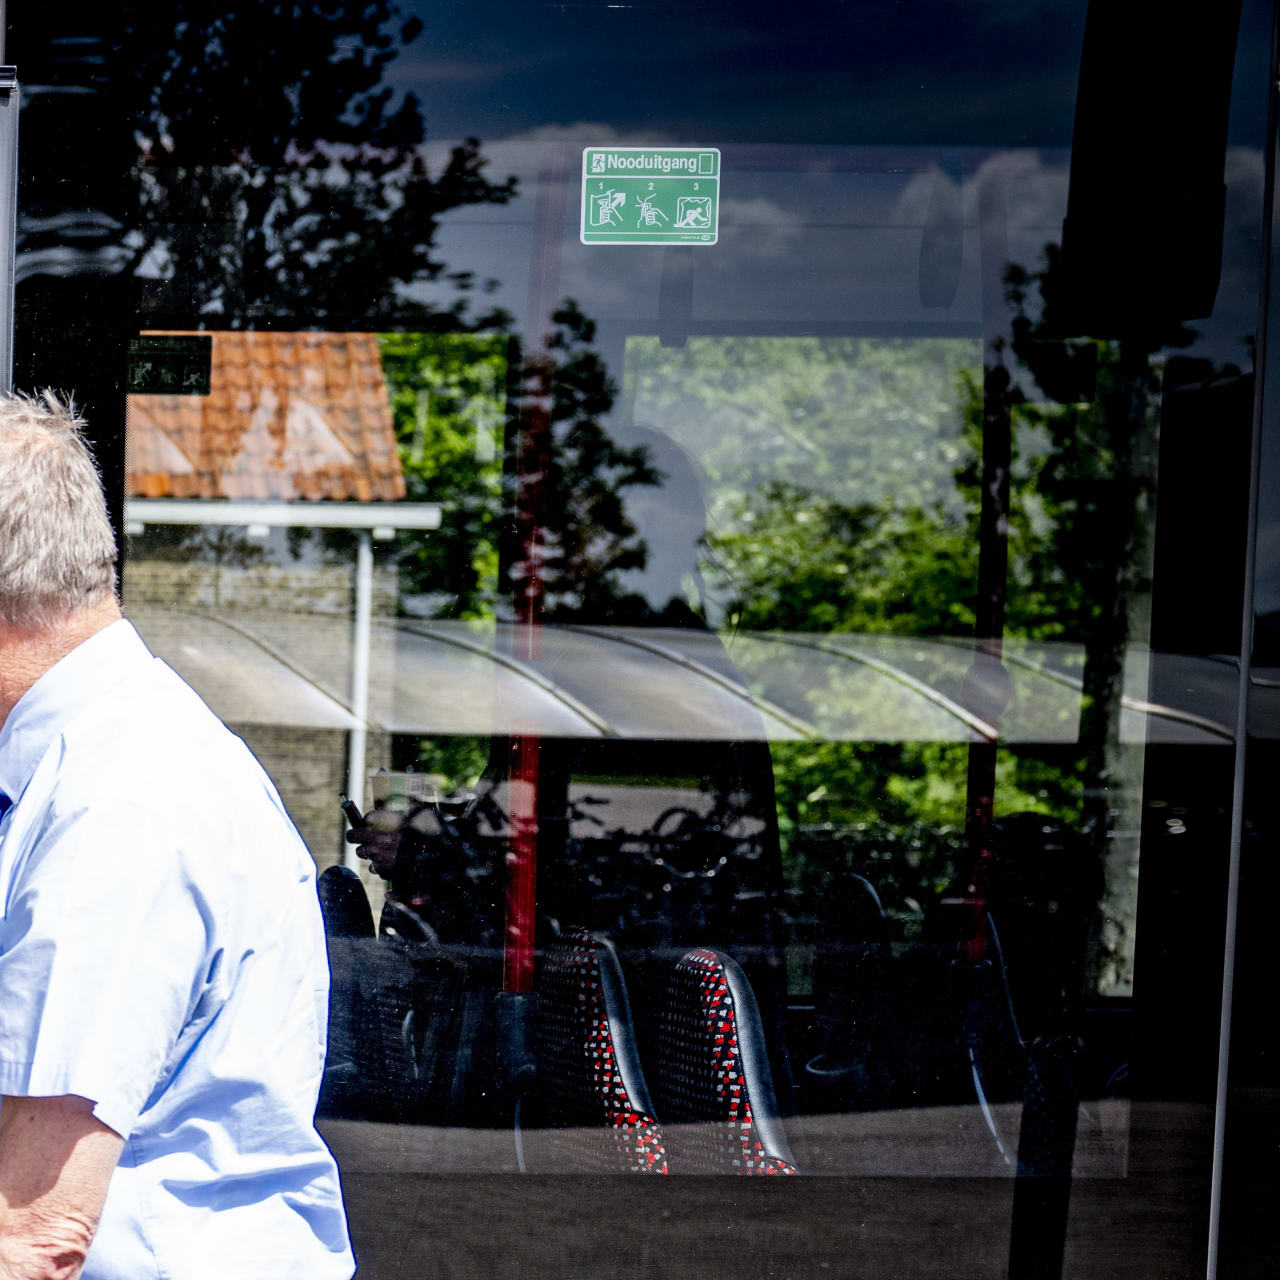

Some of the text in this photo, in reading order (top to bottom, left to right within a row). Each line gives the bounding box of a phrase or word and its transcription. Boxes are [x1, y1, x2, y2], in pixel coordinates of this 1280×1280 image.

[607, 154, 697, 173] Nooduitgang
[598, 182, 699, 191] 1 2 3
